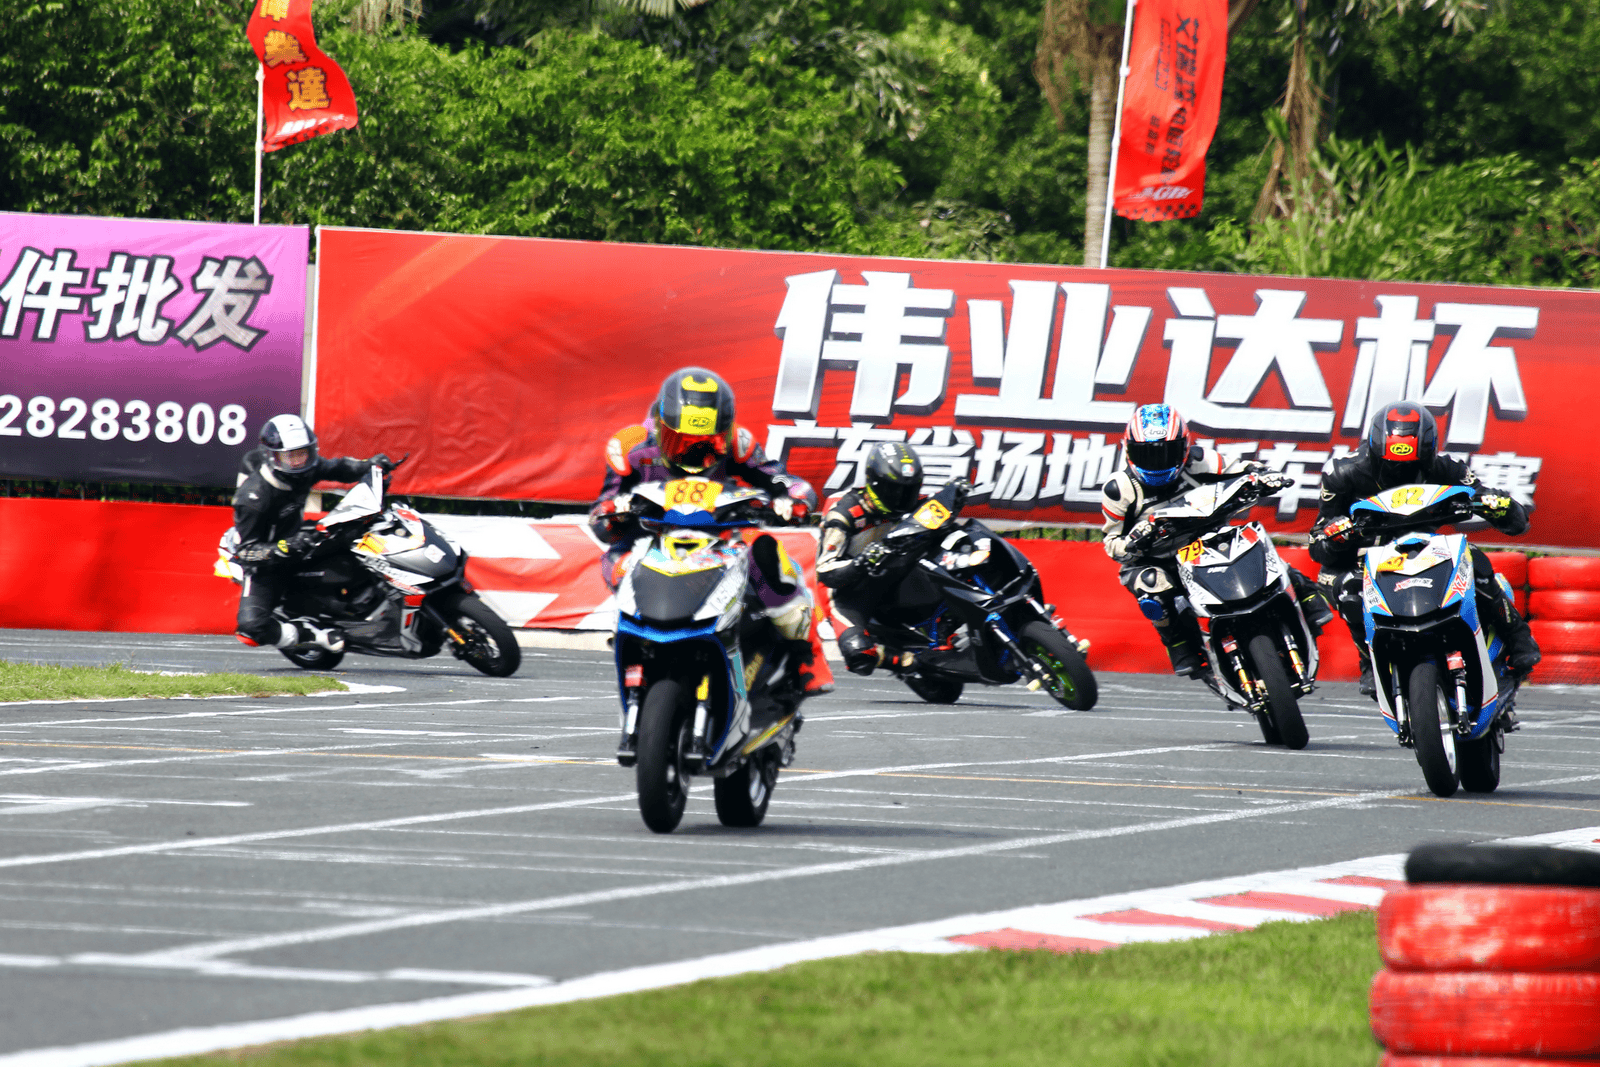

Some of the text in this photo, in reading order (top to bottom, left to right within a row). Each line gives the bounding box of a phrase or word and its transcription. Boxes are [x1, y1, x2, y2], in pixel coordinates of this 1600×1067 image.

[0, 248, 269, 349] 件批发
[773, 268, 1541, 445] 伟业达杯
[0, 395, 247, 445] 28283808
[672, 481, 708, 504] 88
[1390, 487, 1426, 509] 92
[1180, 540, 1202, 561] 79
